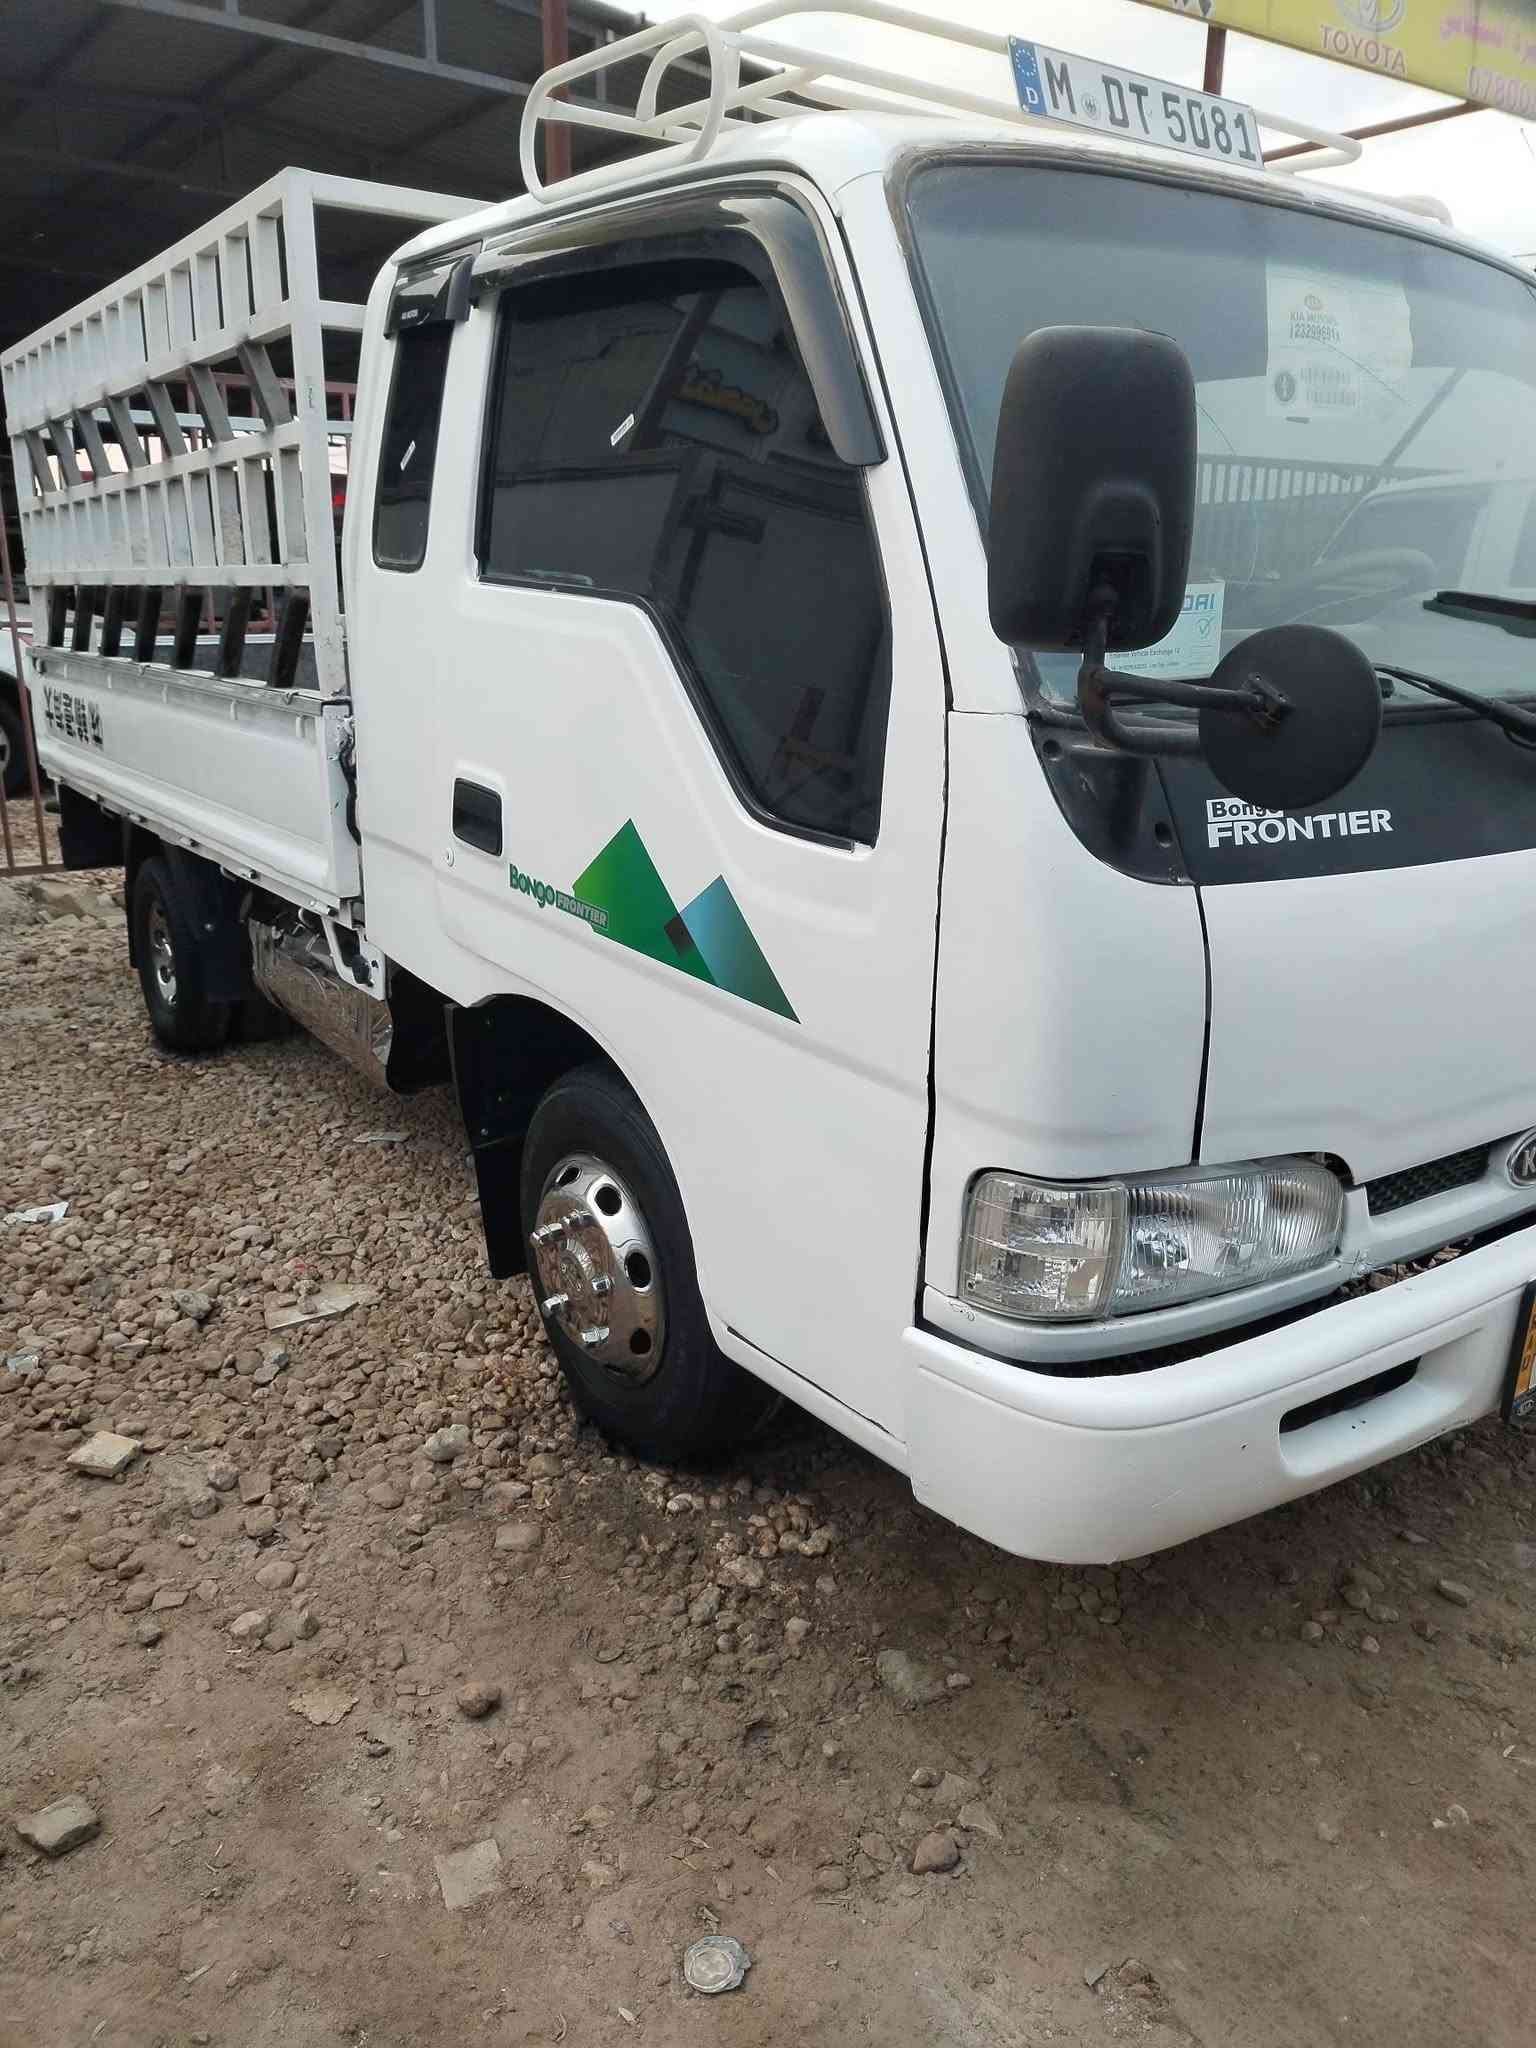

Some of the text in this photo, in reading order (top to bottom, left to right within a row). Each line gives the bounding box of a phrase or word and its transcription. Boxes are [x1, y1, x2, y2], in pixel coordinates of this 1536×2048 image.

[1319, 25, 1406, 74] TOYOTA
[1025, 86, 1039, 105] D
[1044, 57, 1257, 162] M DT 5081
[1183, 593, 1216, 610] DAI
[1207, 809, 1394, 848] FRONTIER
[557, 891, 607, 928] FRONTIER
